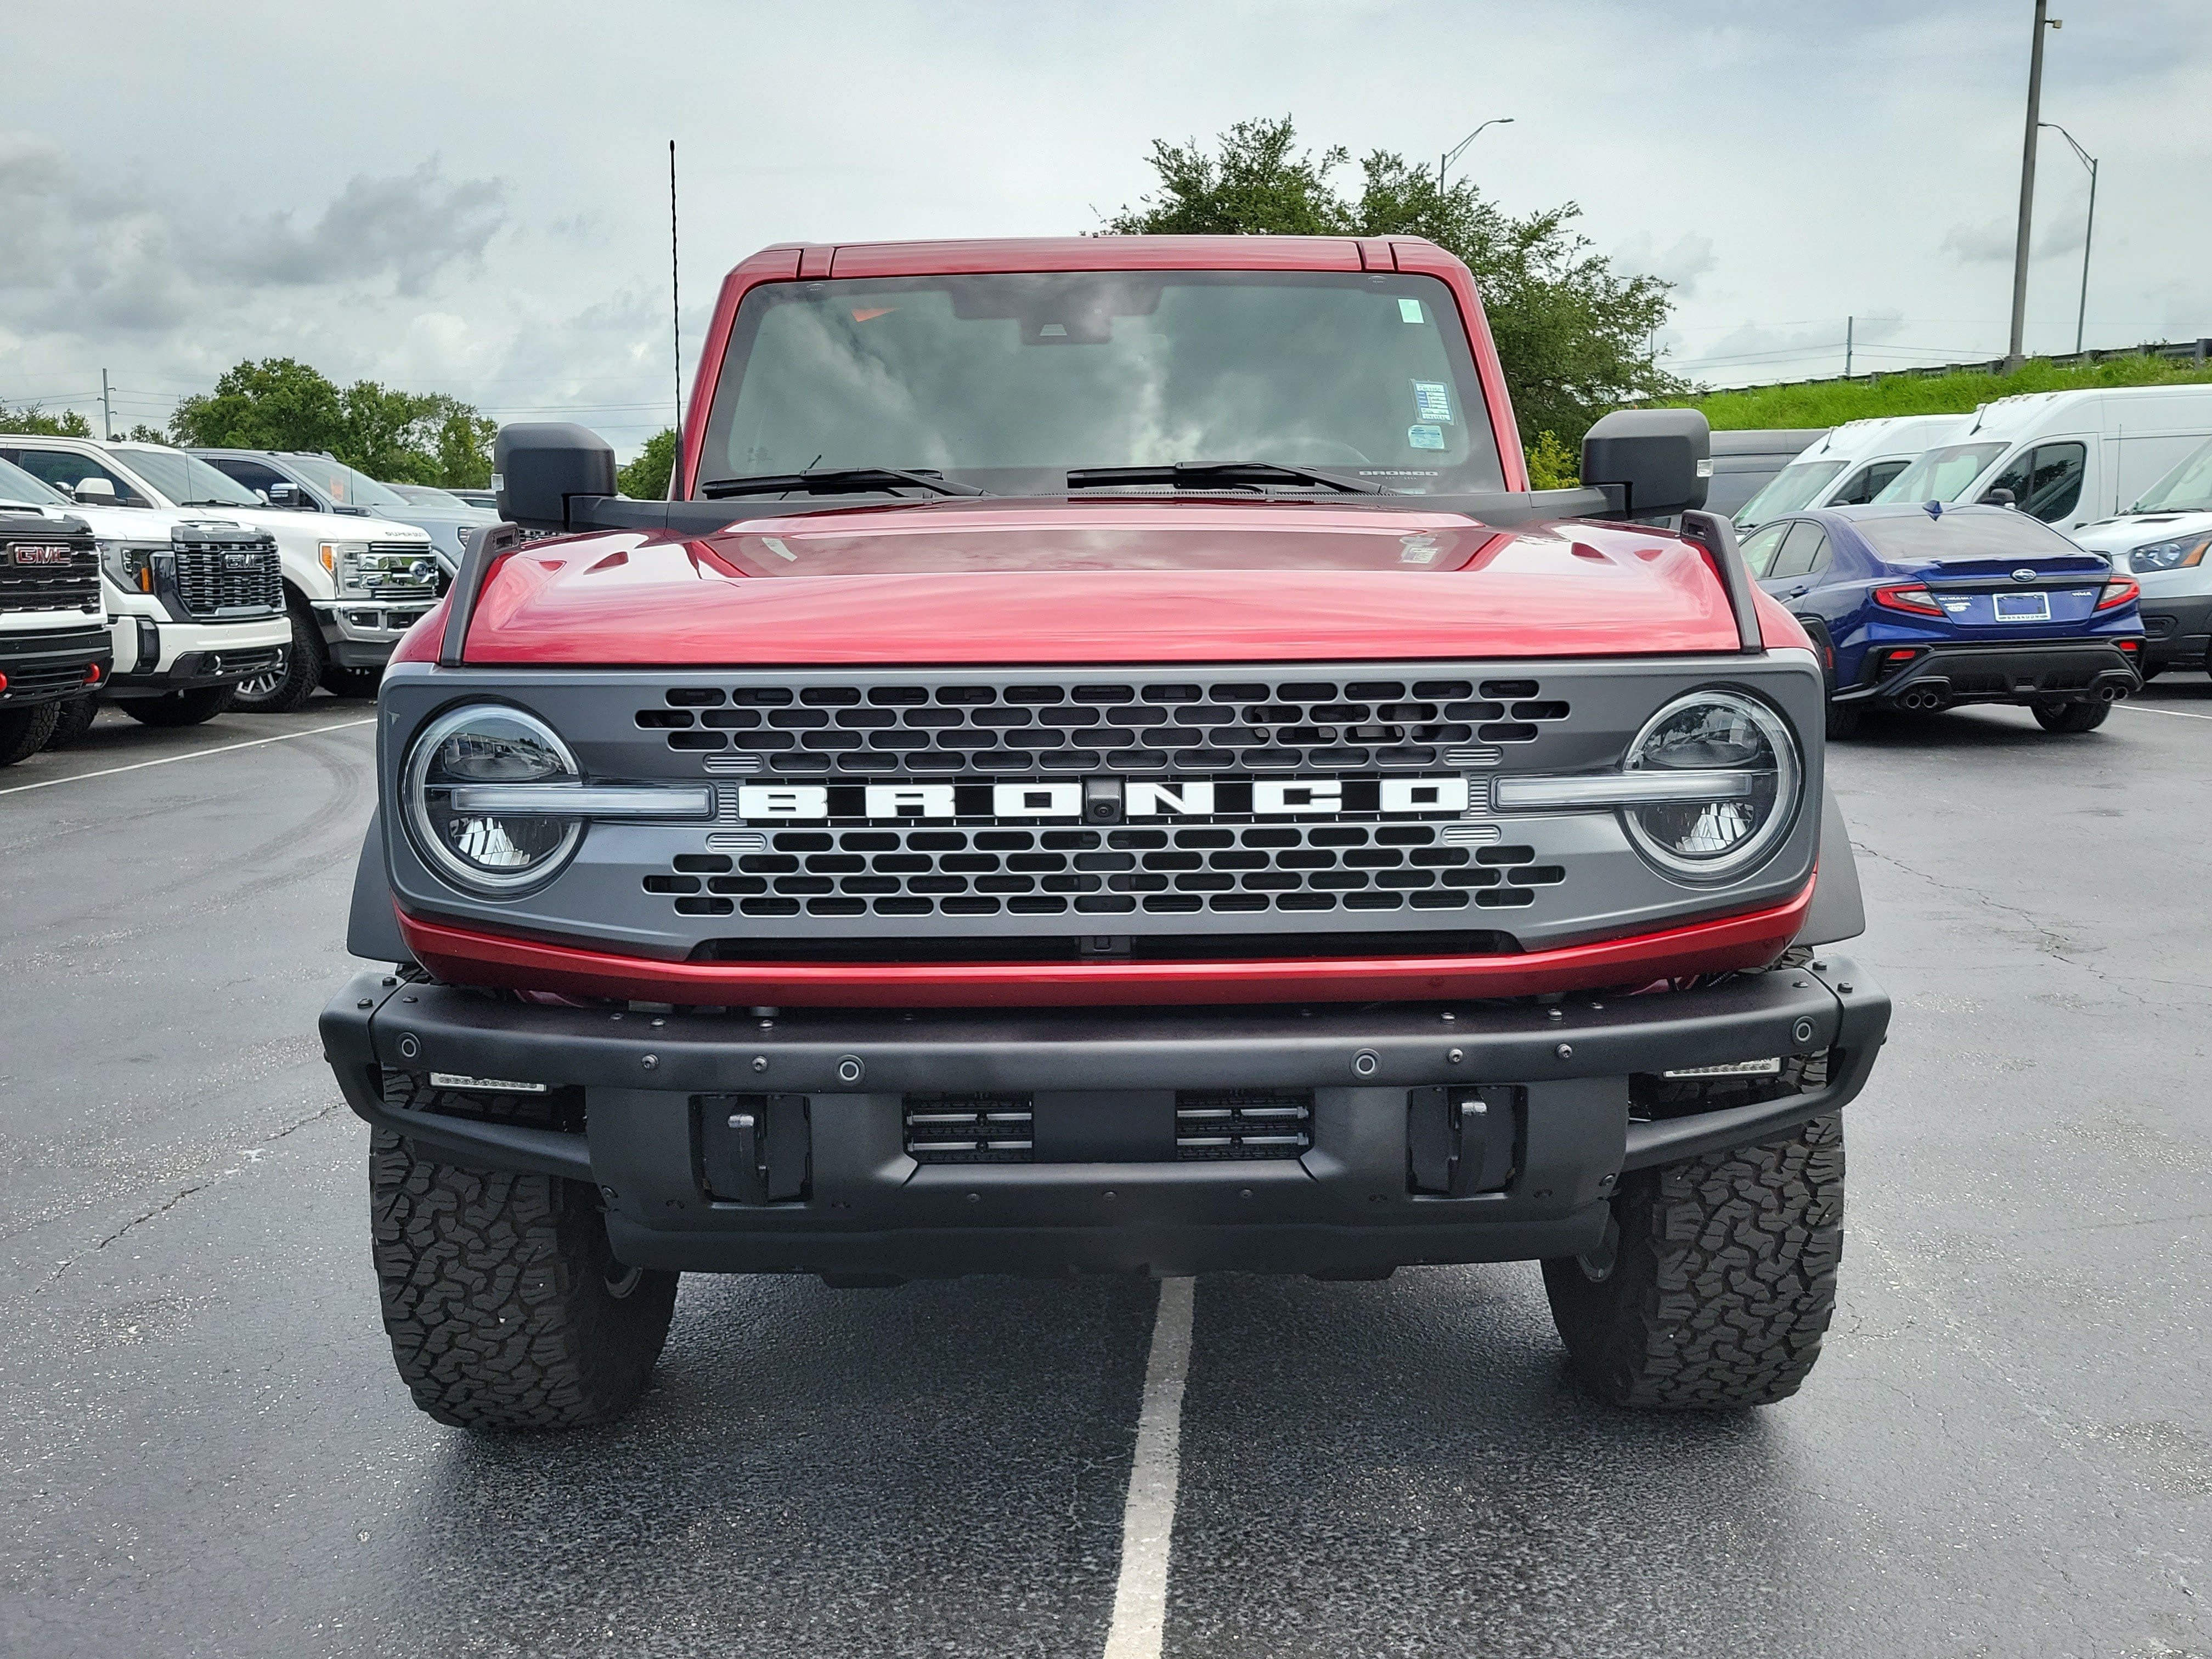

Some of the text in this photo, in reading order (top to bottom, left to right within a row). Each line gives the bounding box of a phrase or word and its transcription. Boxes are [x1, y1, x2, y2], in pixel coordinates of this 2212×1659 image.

[15, 546, 71, 564] GMC
[224, 554, 263, 568] GMC
[738, 777, 1469, 819] BRONCO
